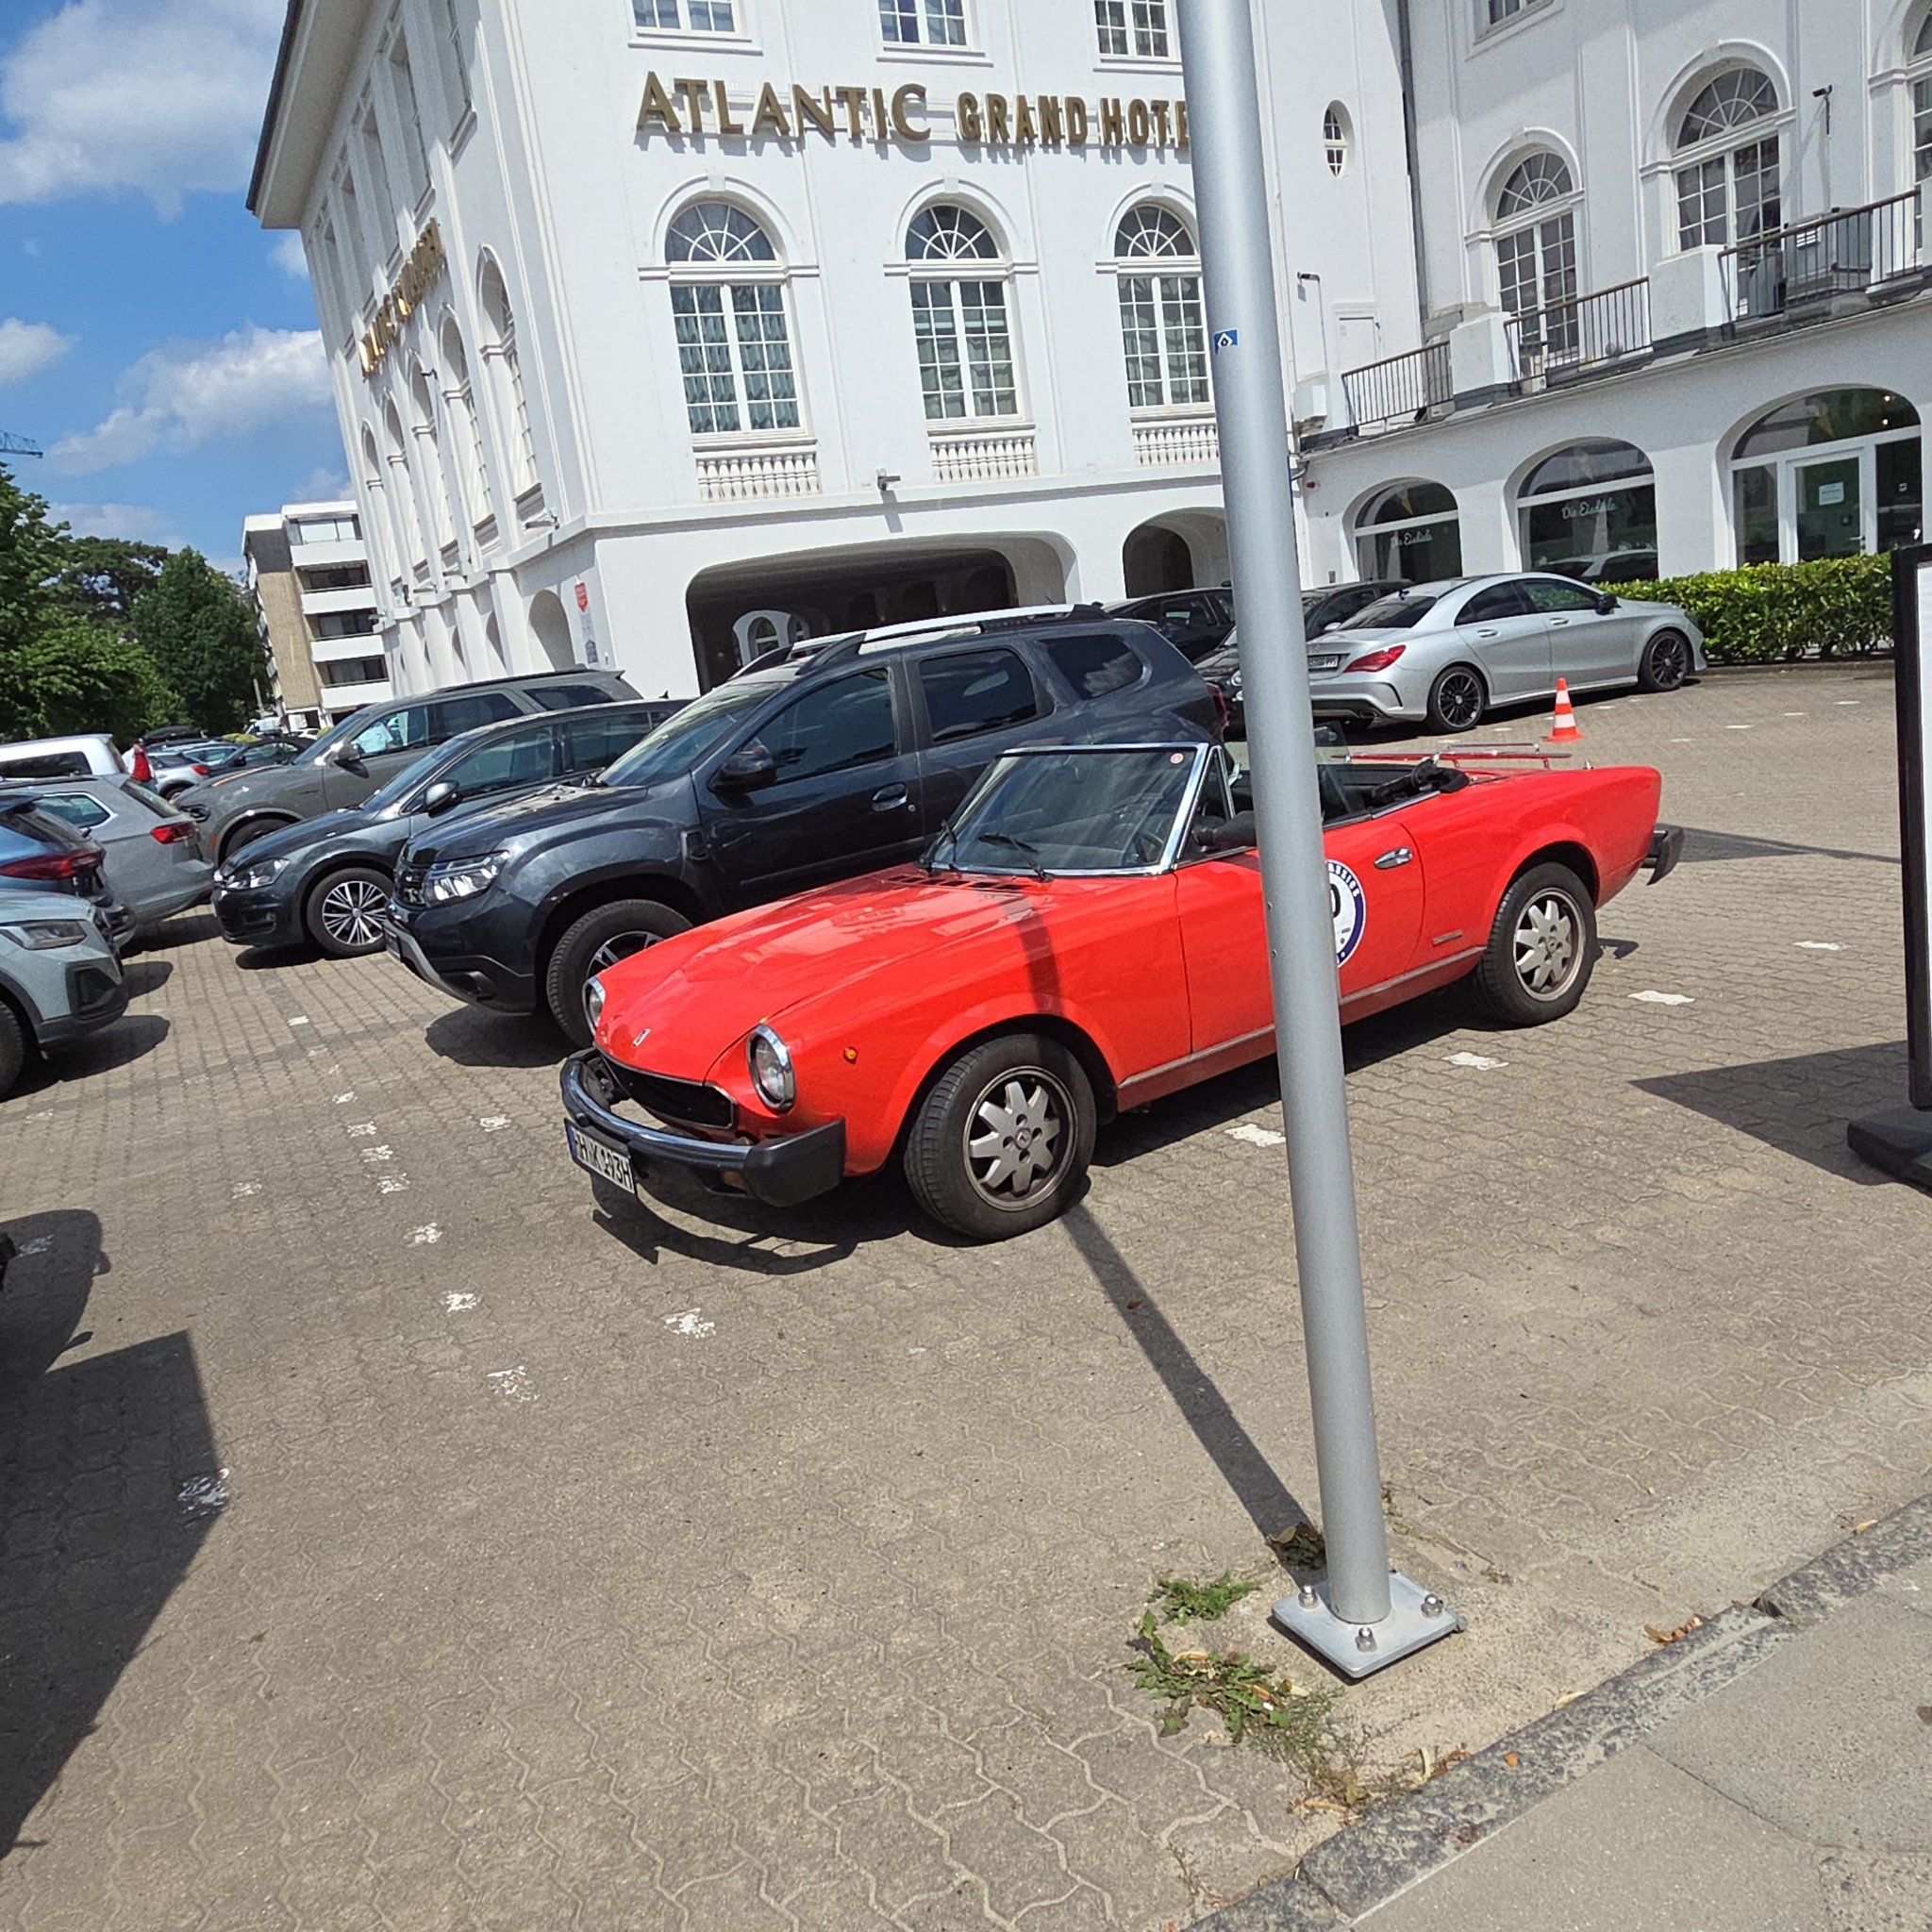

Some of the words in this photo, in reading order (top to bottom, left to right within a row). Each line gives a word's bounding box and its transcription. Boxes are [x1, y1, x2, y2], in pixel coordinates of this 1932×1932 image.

[637, 71, 932, 142] ATLANTIC
[957, 92, 1088, 146] GRAND
[1100, 97, 1189, 148] HOTE
[1328, 862, 1360, 897] ASSICS
